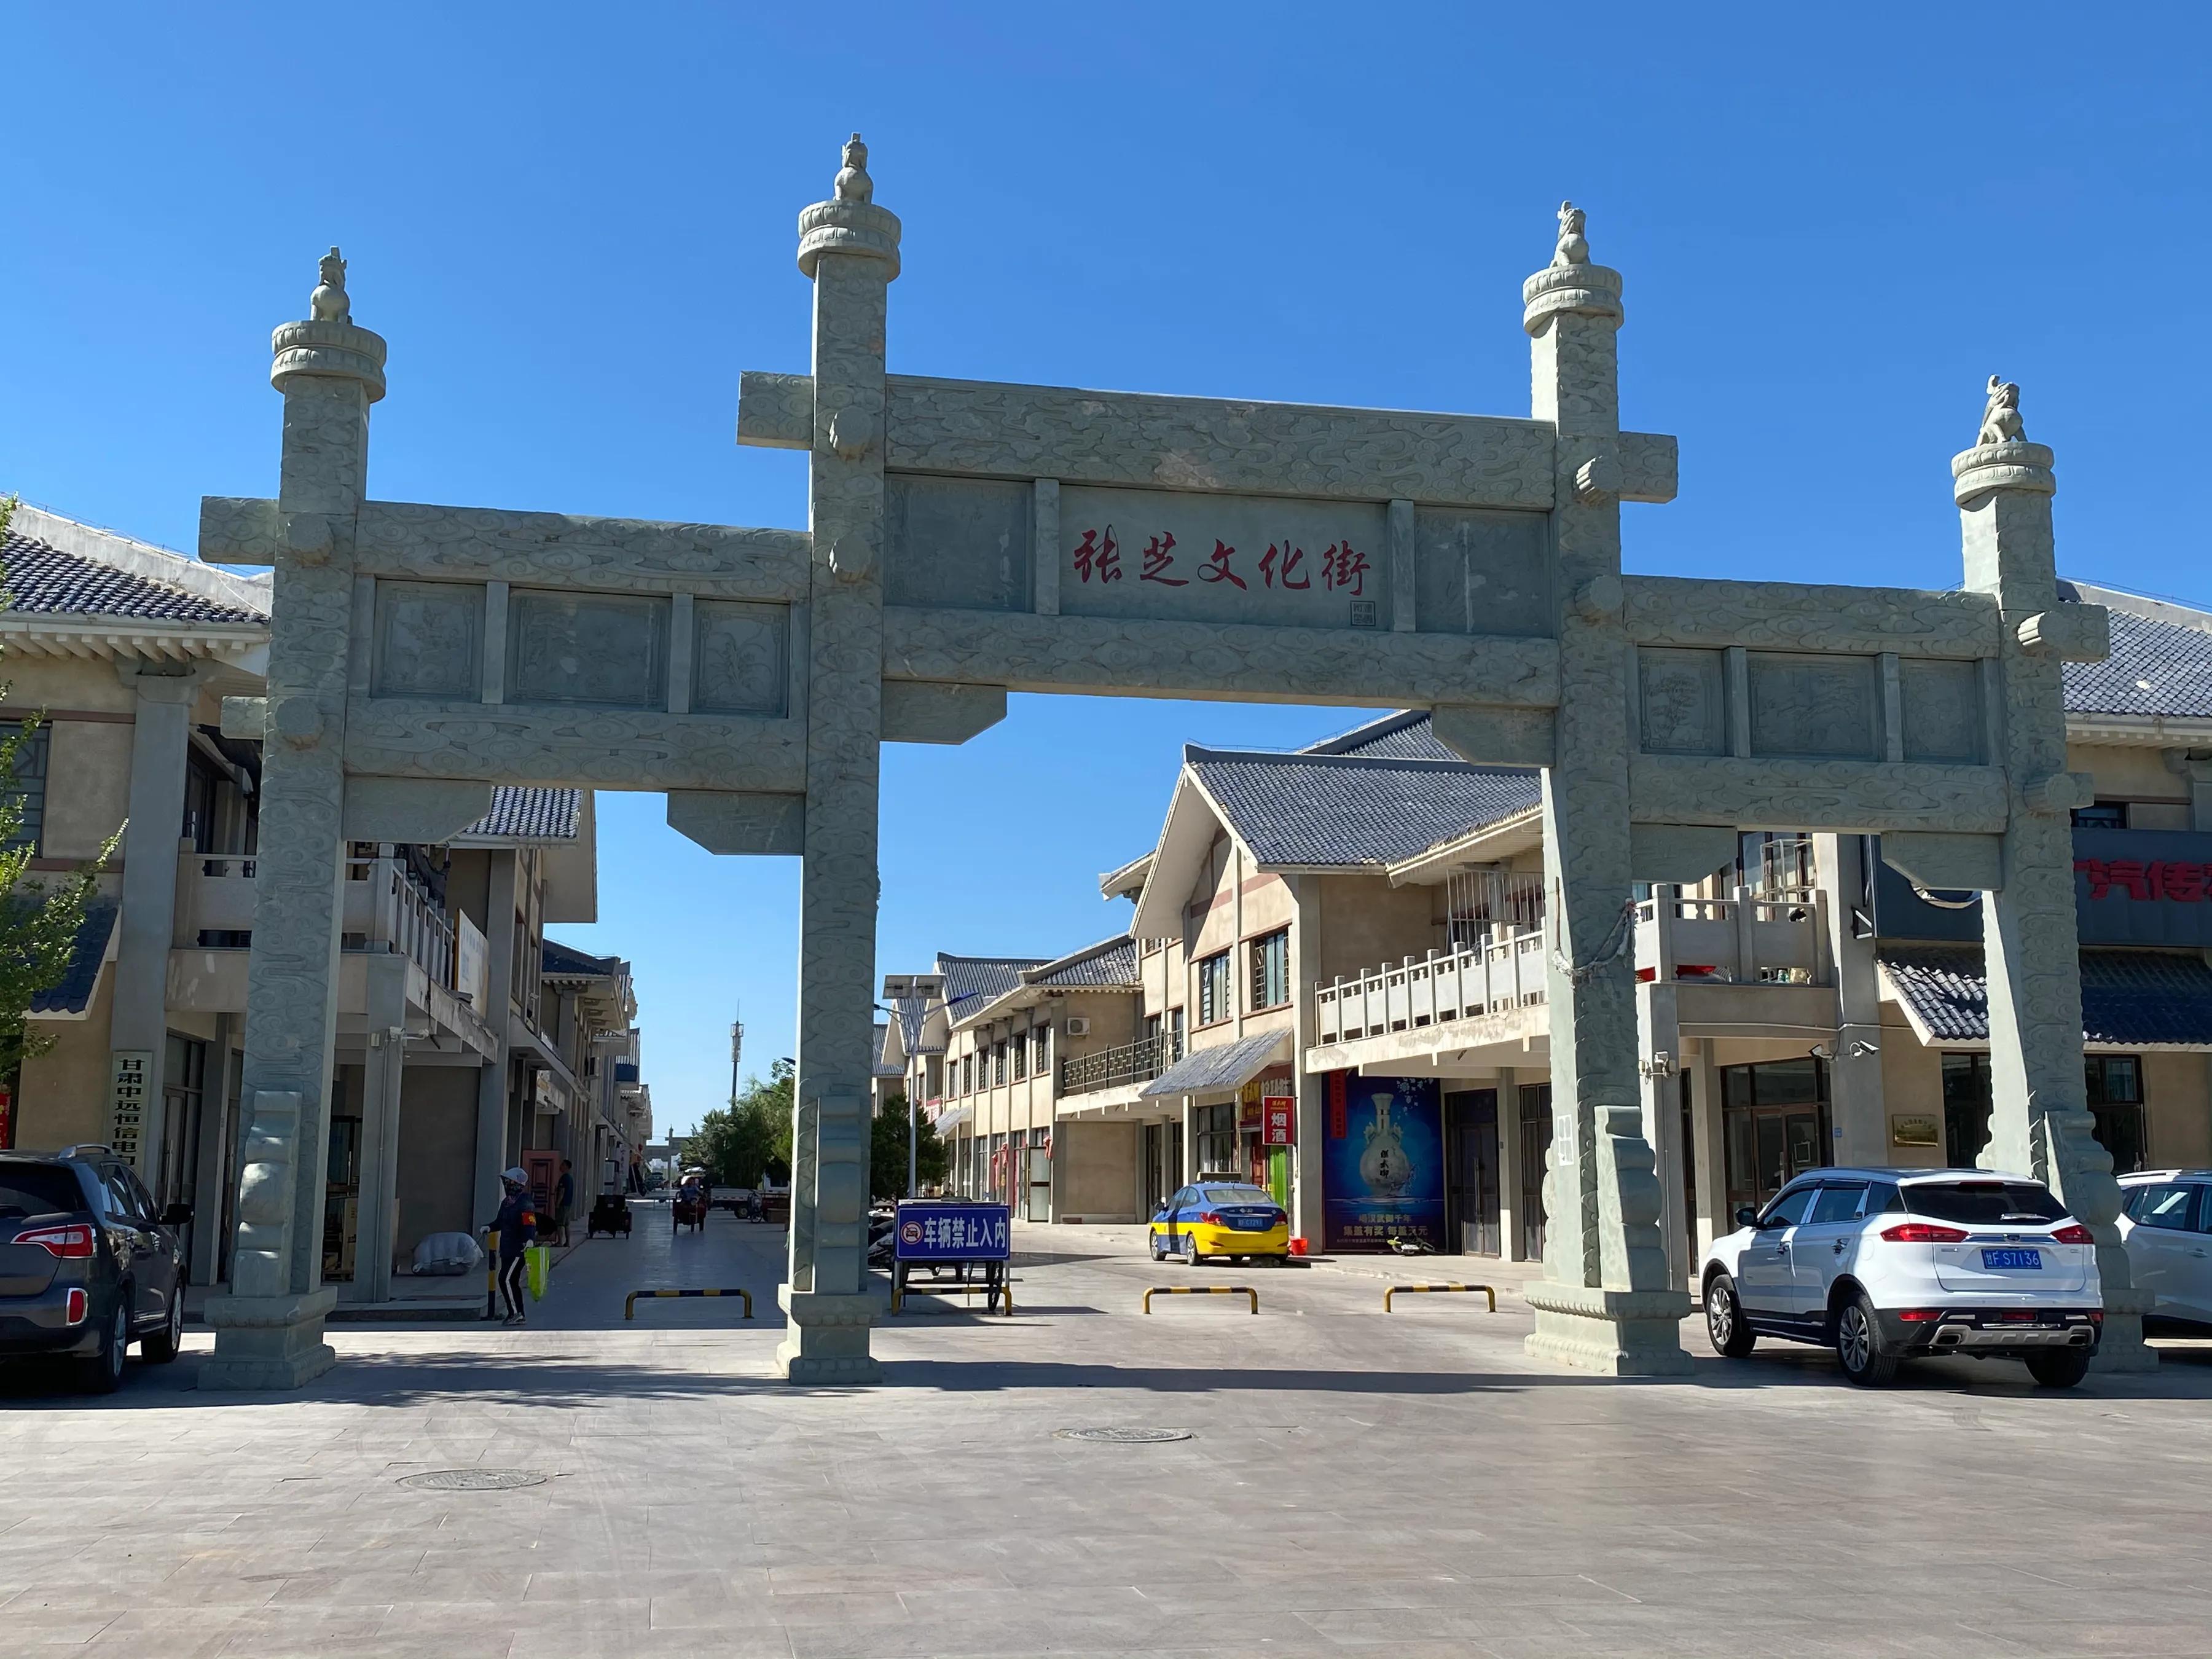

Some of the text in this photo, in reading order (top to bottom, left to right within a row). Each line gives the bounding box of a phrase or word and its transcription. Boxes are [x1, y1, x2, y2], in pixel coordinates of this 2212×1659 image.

[2074, 858, 2212, 902] 汽传
[1271, 1113, 1287, 1143] 烟酒
[924, 1216, 1006, 1249] 车辆禁止入内
